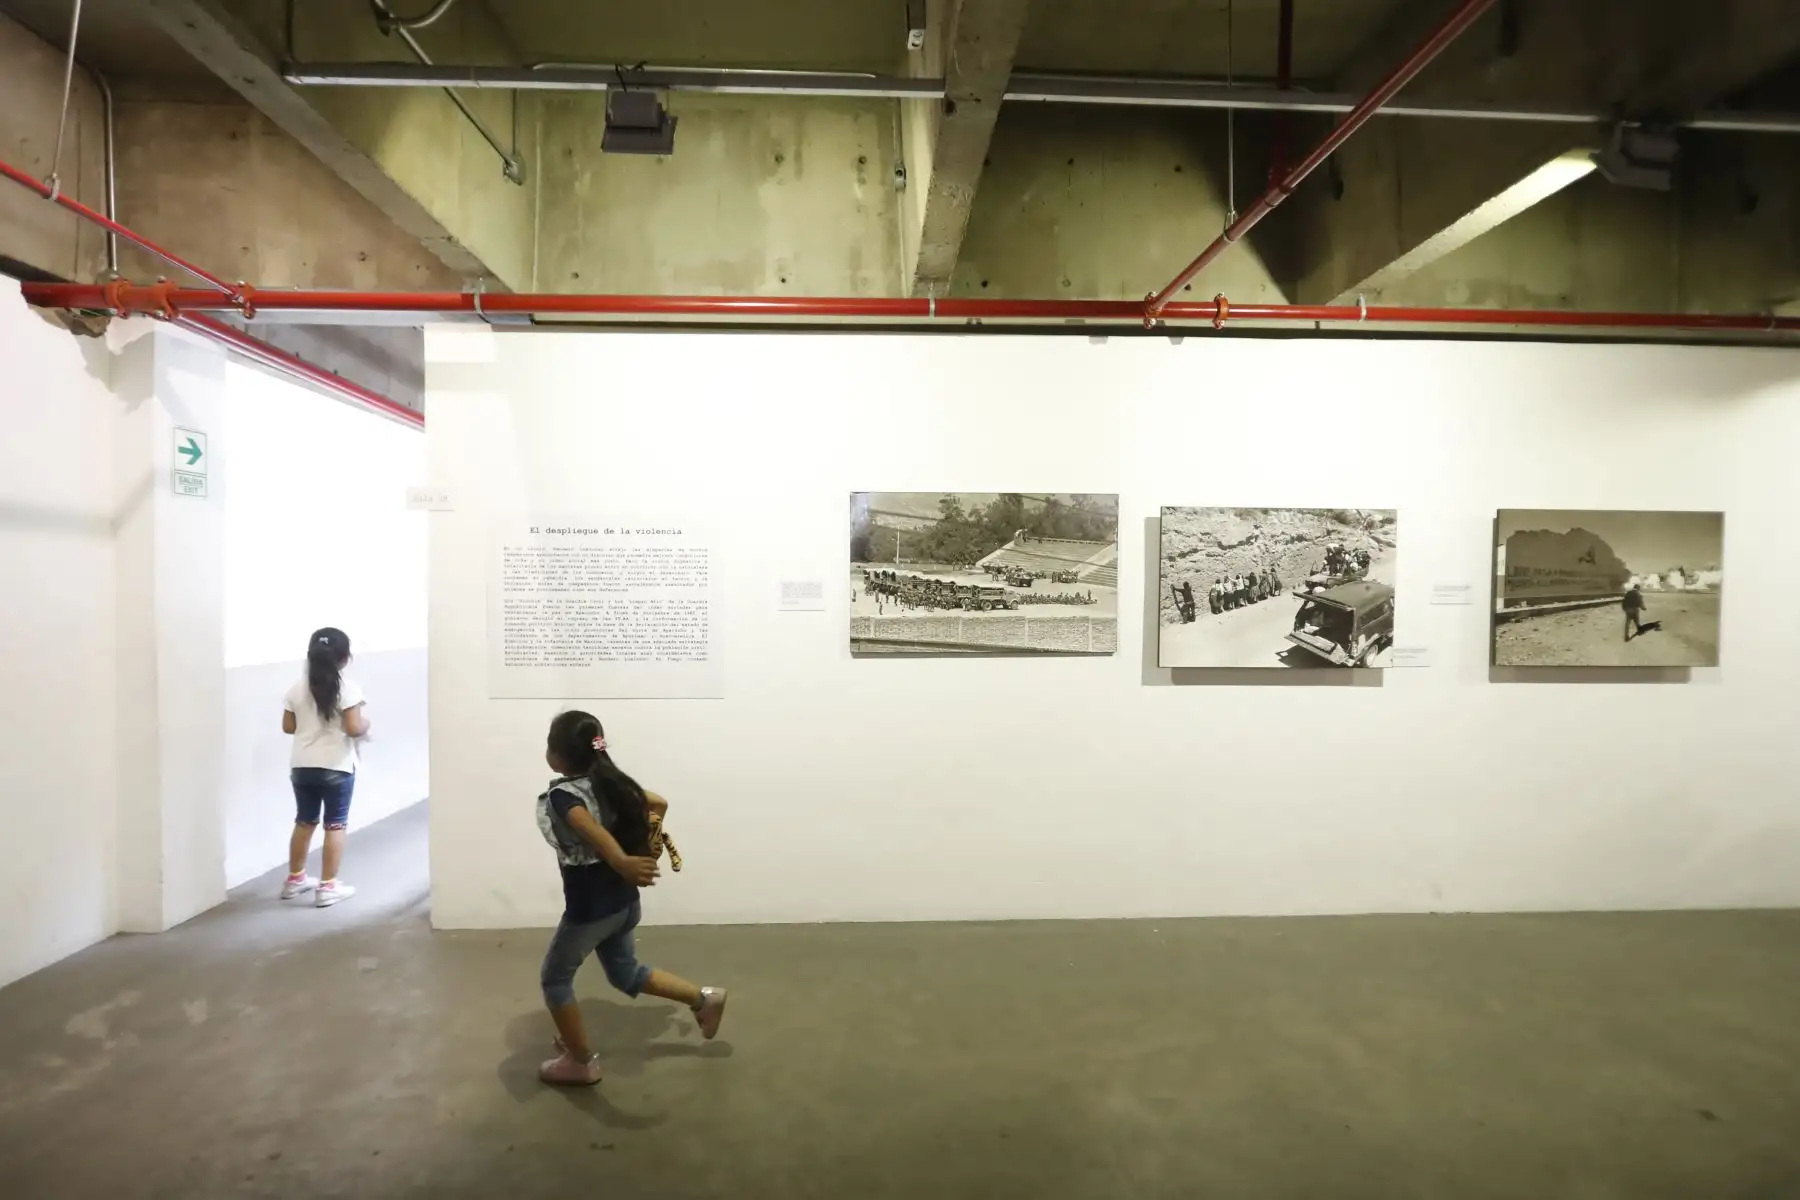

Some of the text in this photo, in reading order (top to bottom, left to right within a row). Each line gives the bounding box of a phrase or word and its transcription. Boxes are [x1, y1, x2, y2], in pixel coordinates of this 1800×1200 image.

[178, 476, 204, 486] SALIDA
[184, 486, 198, 494] EXIT
[545, 527, 599, 536] despliegue
